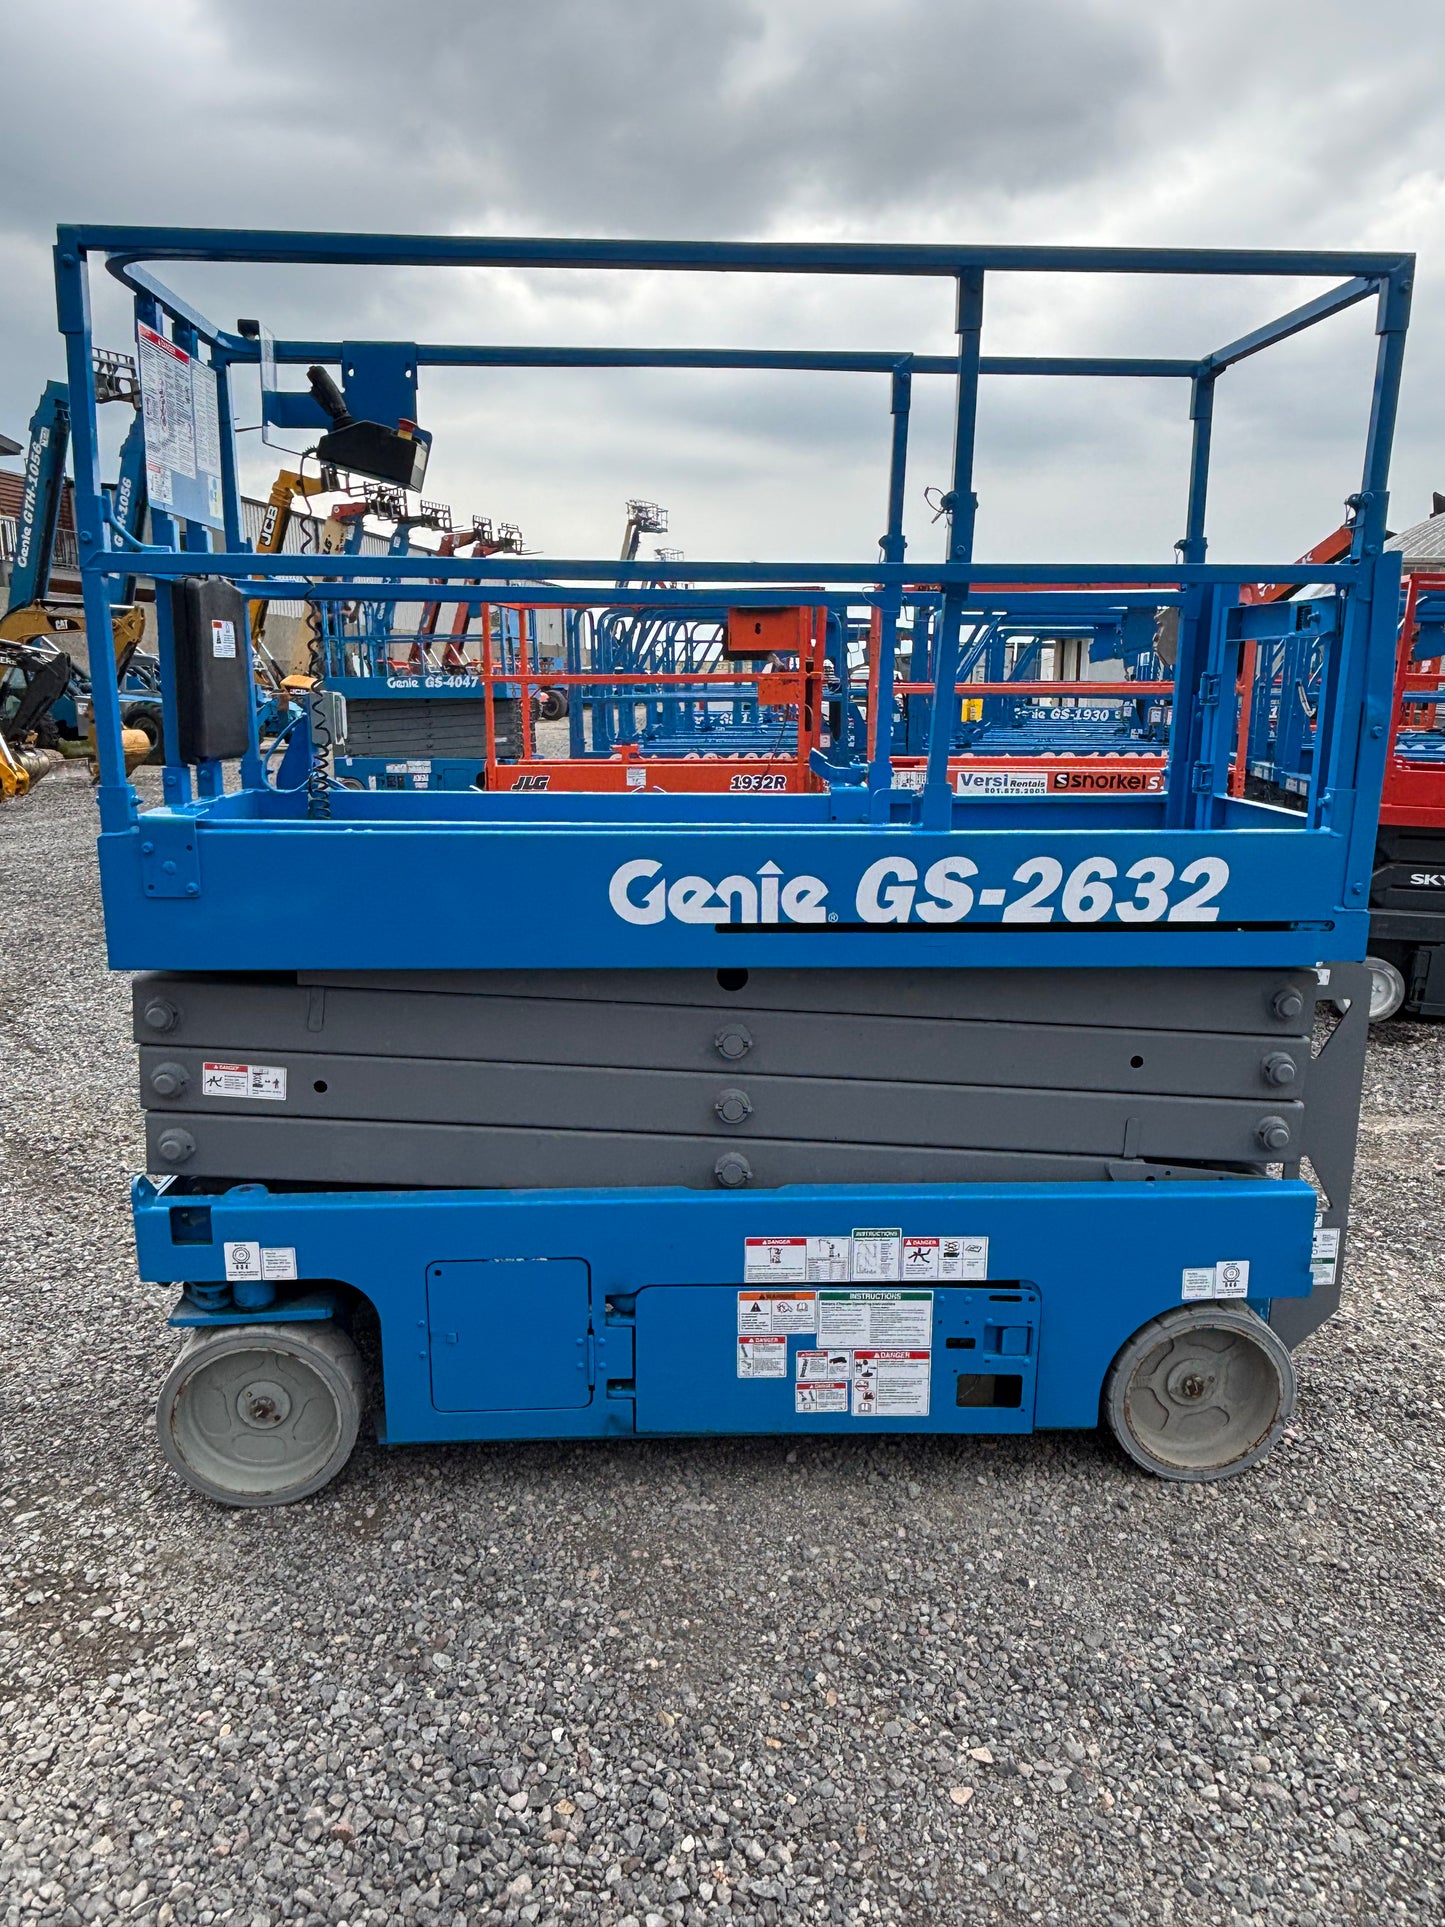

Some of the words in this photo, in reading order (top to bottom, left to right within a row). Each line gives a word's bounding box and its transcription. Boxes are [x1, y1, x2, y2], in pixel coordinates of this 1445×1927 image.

[23, 441, 43, 525] GTH-1056
[113, 477, 132, 547] GH-1056
[259, 505, 279, 546] JCB
[18, 526, 32, 568] Genie
[55, 619, 69, 631] CAT
[386, 676, 420, 689] Genie
[424, 675, 480, 689] GS-4047
[1050, 707, 1110, 721] GS-1930
[511, 775, 550, 791] JLG
[730, 774, 786, 791] 1932R
[960, 773, 1008, 787] Versi
[1009, 779, 1046, 788] Rentals
[1070, 772, 1146, 789] snorkel
[608, 859, 830, 925] Genie
[855, 855, 1231, 924] GS-2632
[880, 1351, 911, 1359] DANGER
